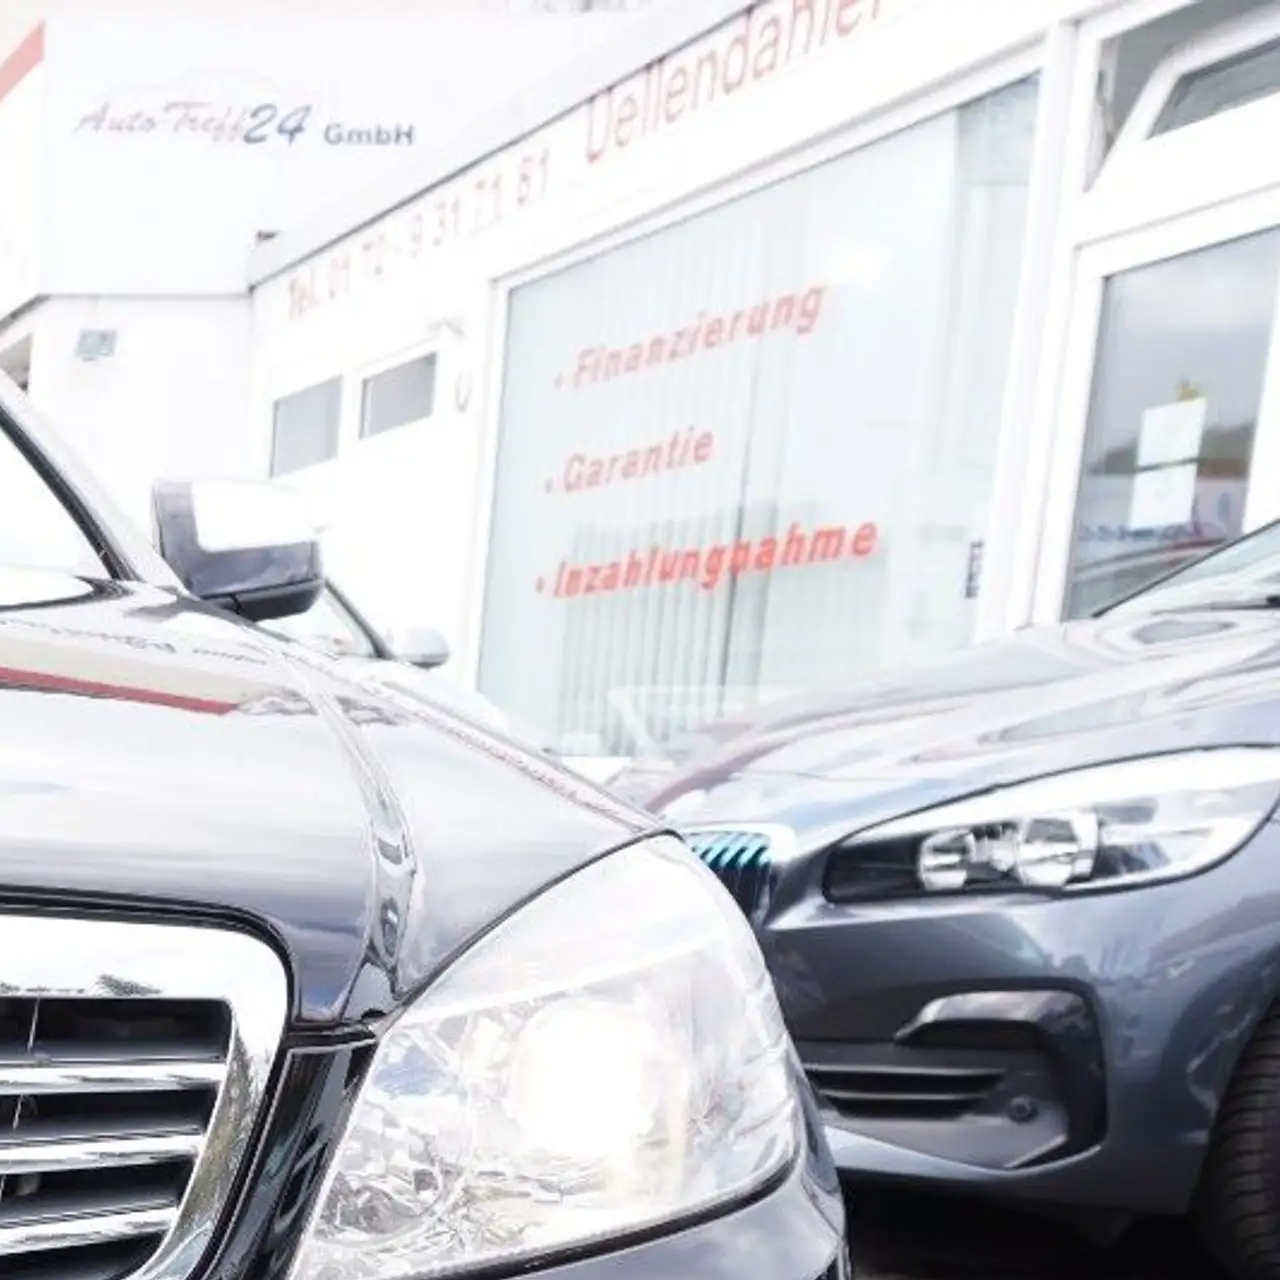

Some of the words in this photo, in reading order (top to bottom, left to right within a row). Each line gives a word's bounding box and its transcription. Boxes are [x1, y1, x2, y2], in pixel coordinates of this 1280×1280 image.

[242, 102, 314, 147] 24
[323, 124, 416, 147] GmbH
[574, 285, 826, 390] Finanzierung
[564, 425, 714, 493] Garantie
